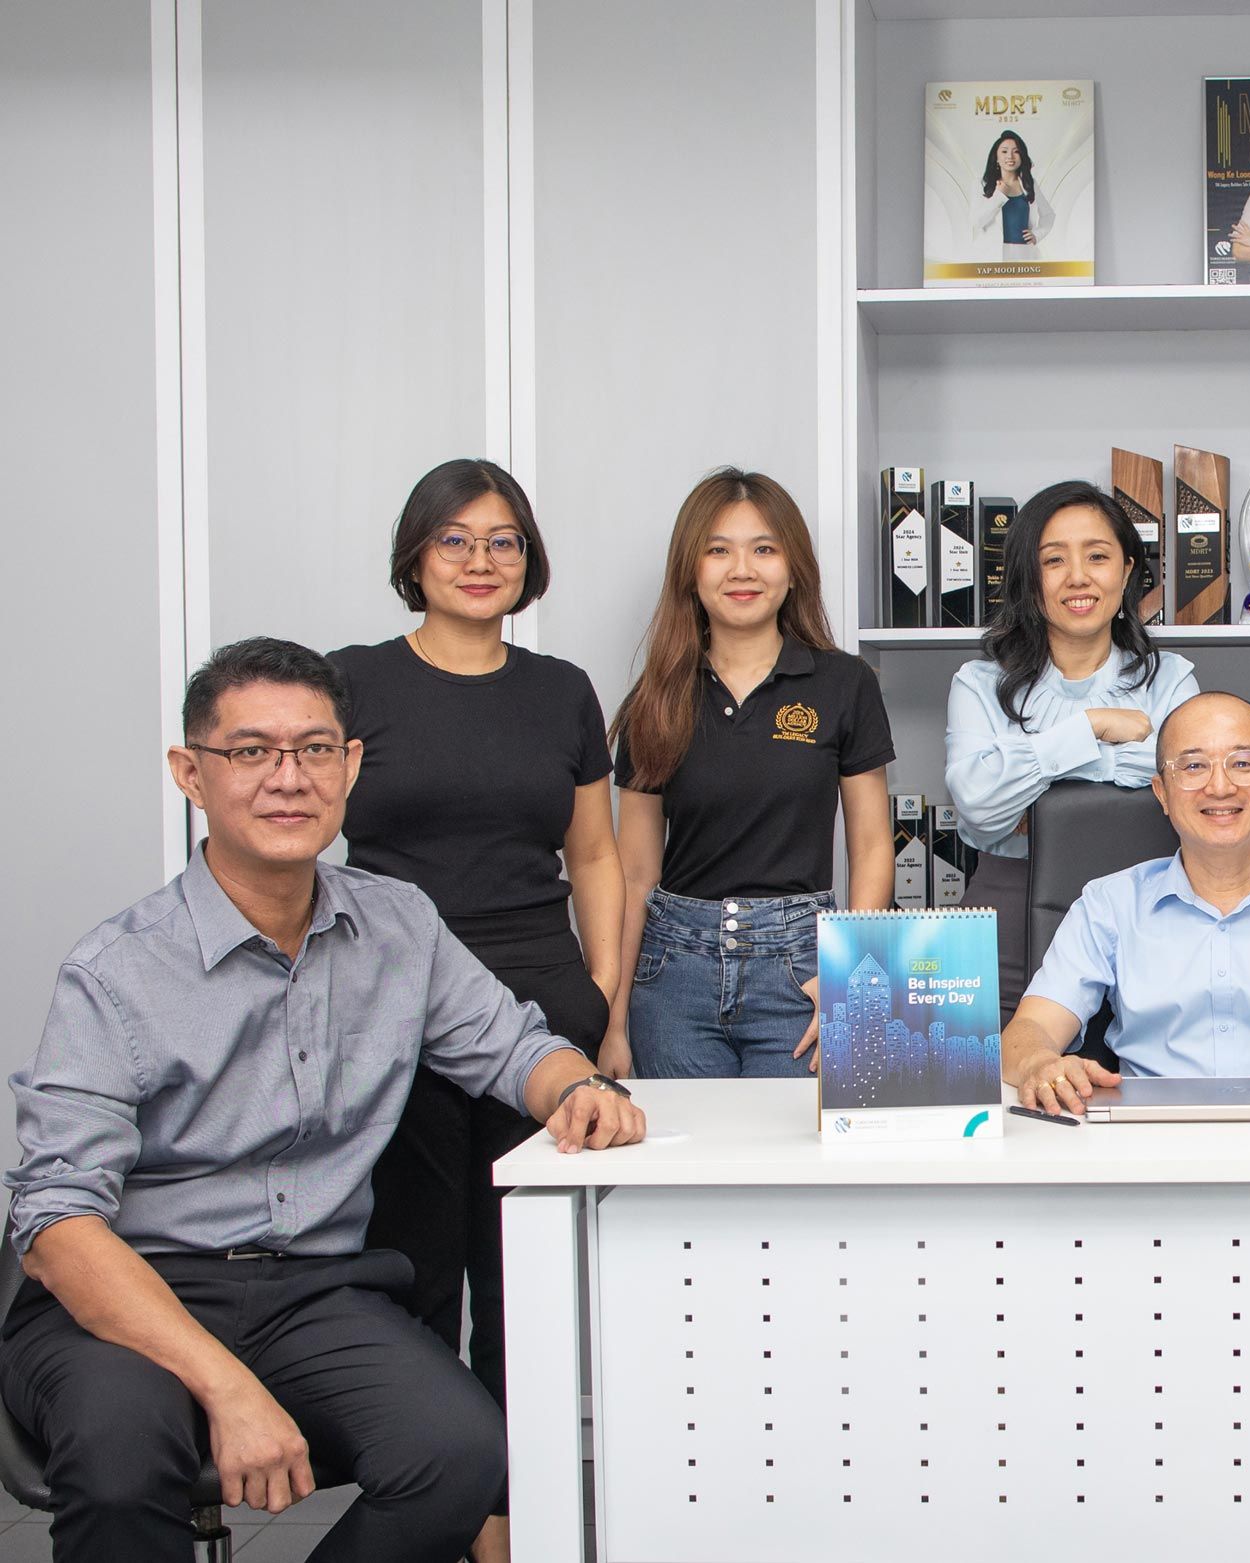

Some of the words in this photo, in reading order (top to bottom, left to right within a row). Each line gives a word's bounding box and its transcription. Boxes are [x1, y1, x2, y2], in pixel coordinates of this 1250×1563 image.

[975, 94, 1043, 115] MDRT
[1208, 171, 1225, 180] Wong
[911, 961, 938, 971] 2026
[908, 977, 926, 990] Be
[928, 976, 981, 991] Inspired
[908, 993, 945, 1006] Every
[948, 992, 975, 1006] Day
